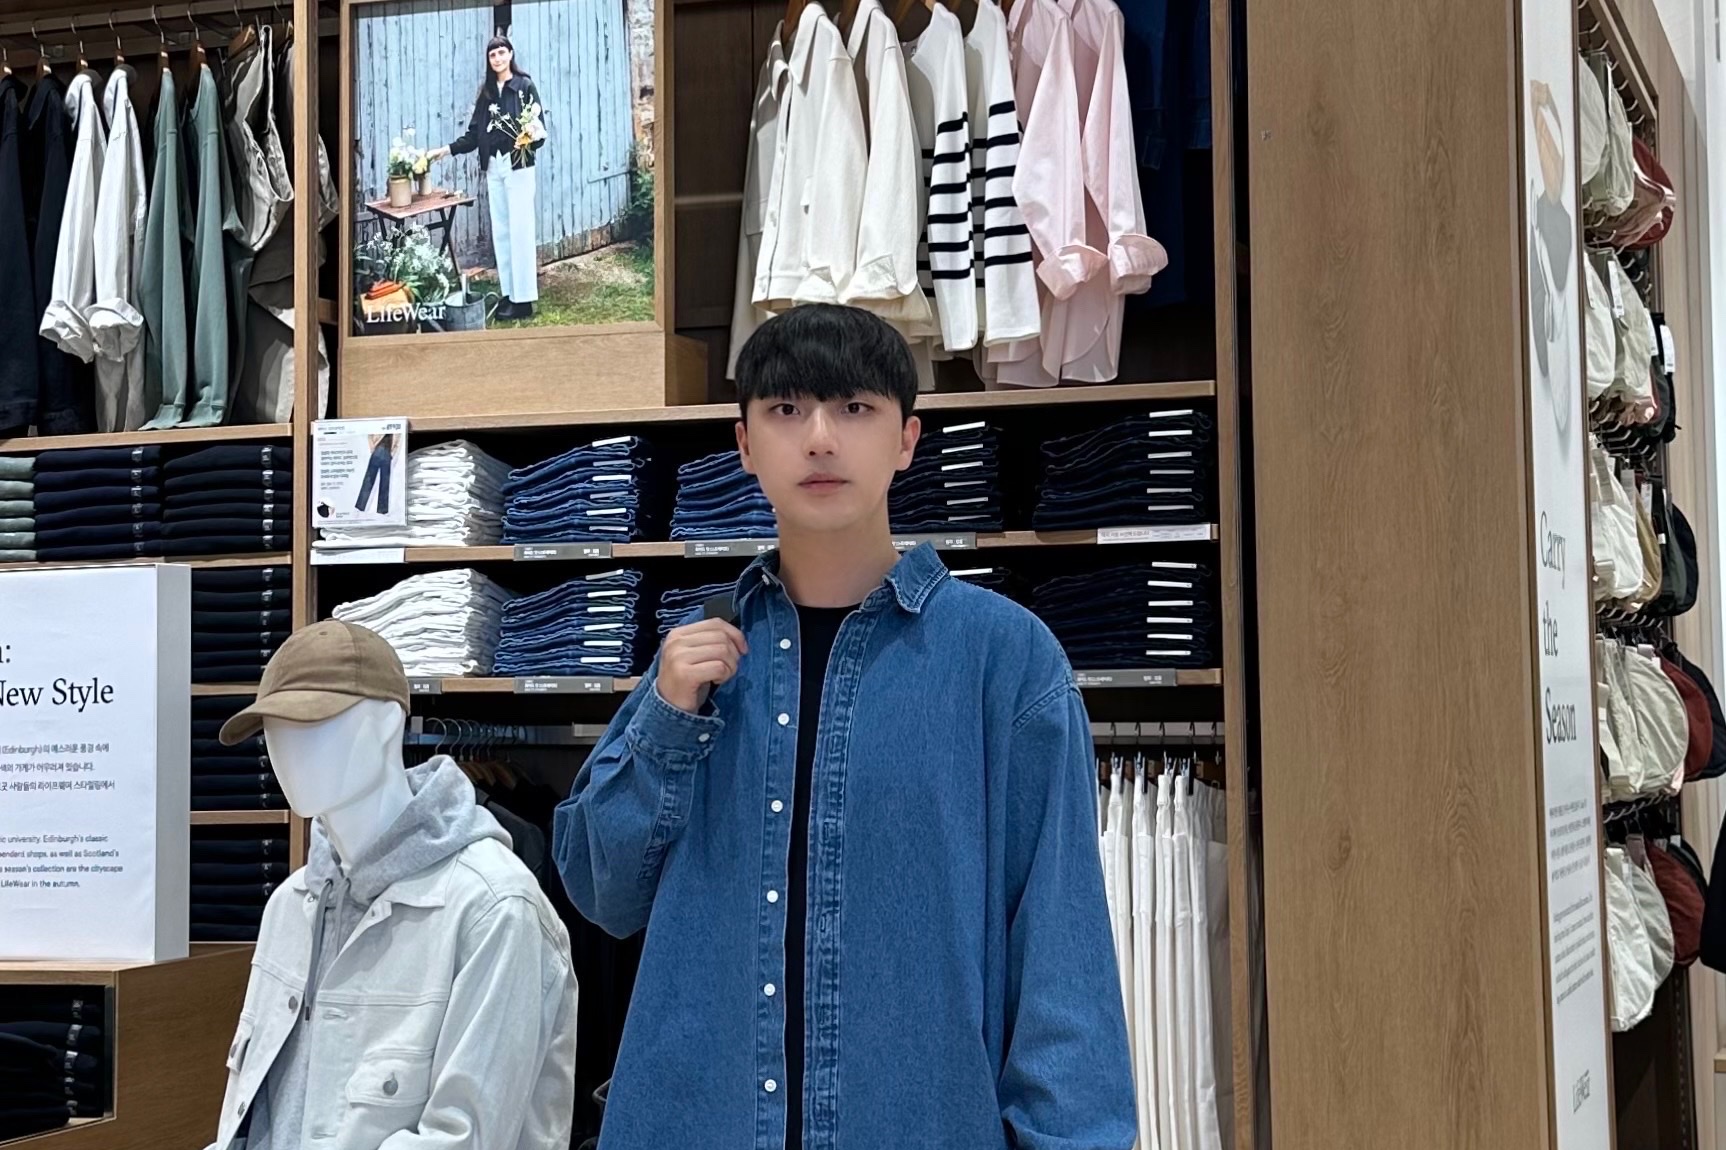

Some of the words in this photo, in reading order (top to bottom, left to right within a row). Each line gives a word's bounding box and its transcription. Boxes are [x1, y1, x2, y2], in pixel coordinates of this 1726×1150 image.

[366, 303, 446, 323] LifeWear
[1540, 510, 1566, 590] Carry
[1543, 600, 1558, 656] the
[52, 677, 114, 713] Style
[1545, 687, 1577, 744] Season
